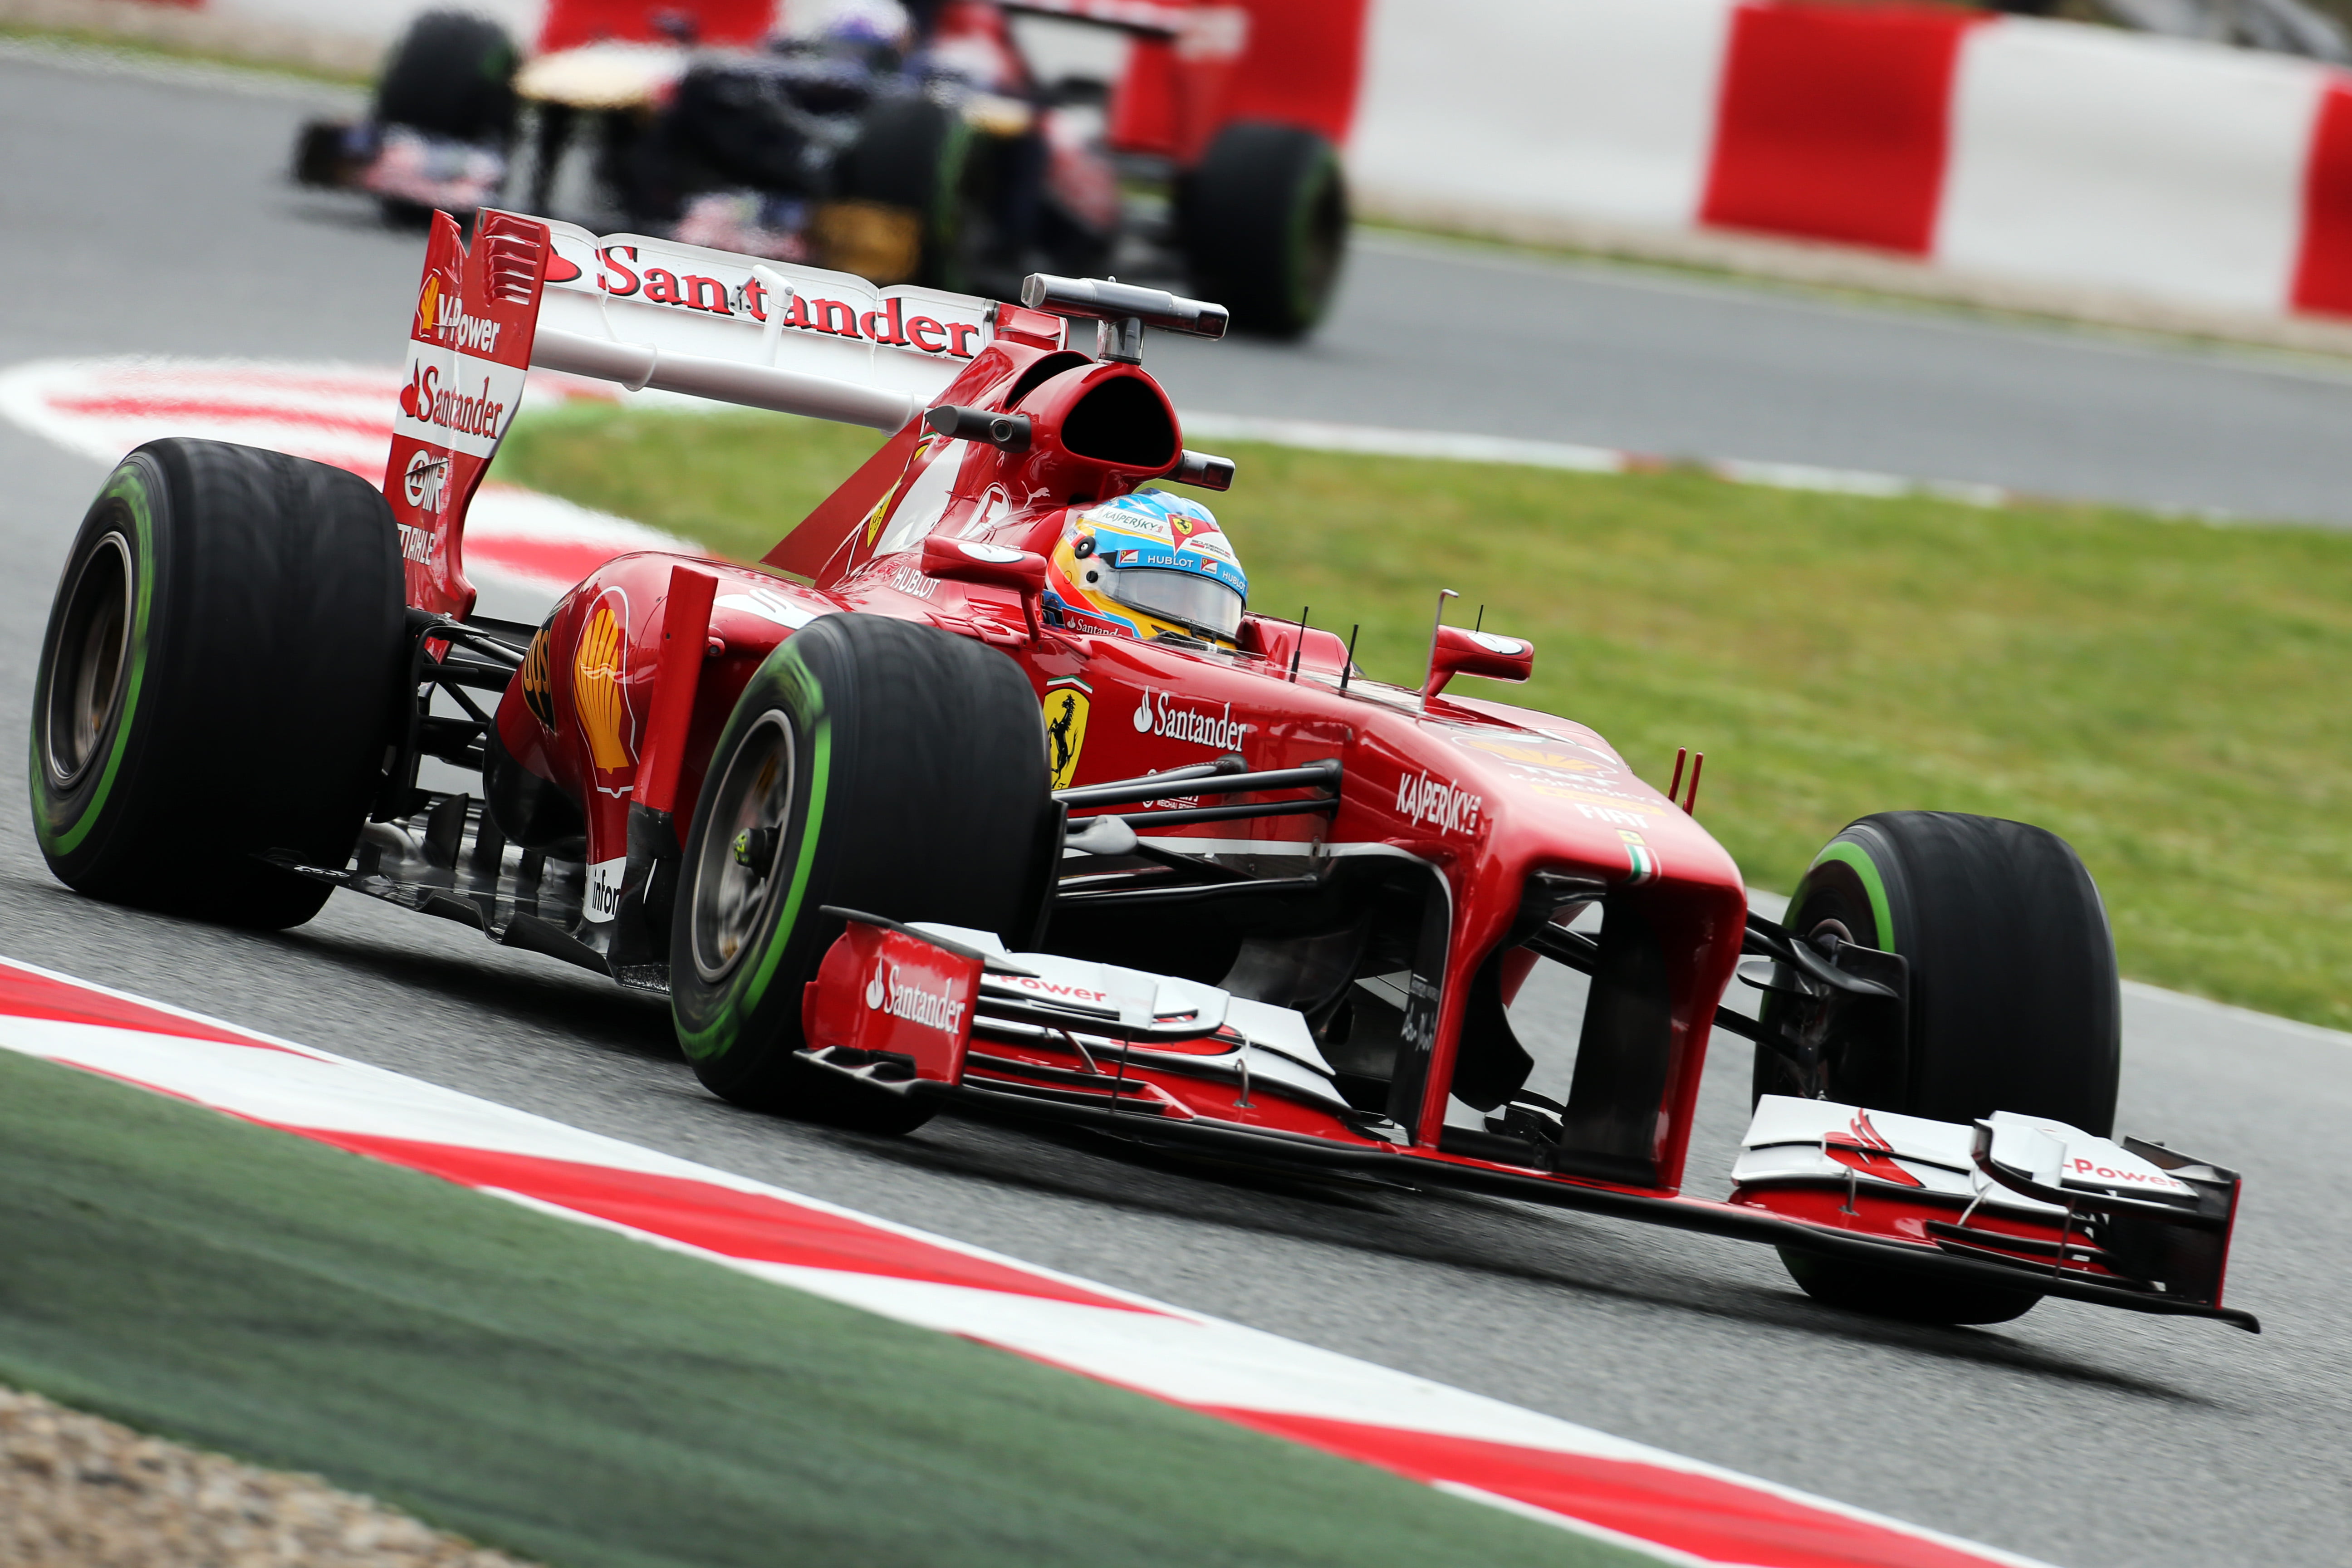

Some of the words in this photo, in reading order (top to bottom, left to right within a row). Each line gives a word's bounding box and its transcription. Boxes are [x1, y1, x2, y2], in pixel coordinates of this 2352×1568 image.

[597, 245, 979, 359] Santander
[417, 364, 503, 440] Santander
[1103, 511, 1158, 529] KASPERSKY
[890, 565, 941, 599] HUBLOT
[1147, 555, 1194, 568] HUBLOT
[1222, 570, 1246, 594] HUBLOT
[1154, 691, 1248, 752] Santander
[1396, 769, 1475, 837] KASPERSKY
[1573, 804, 1650, 829] FIAT
[884, 965, 965, 1034] Santander
